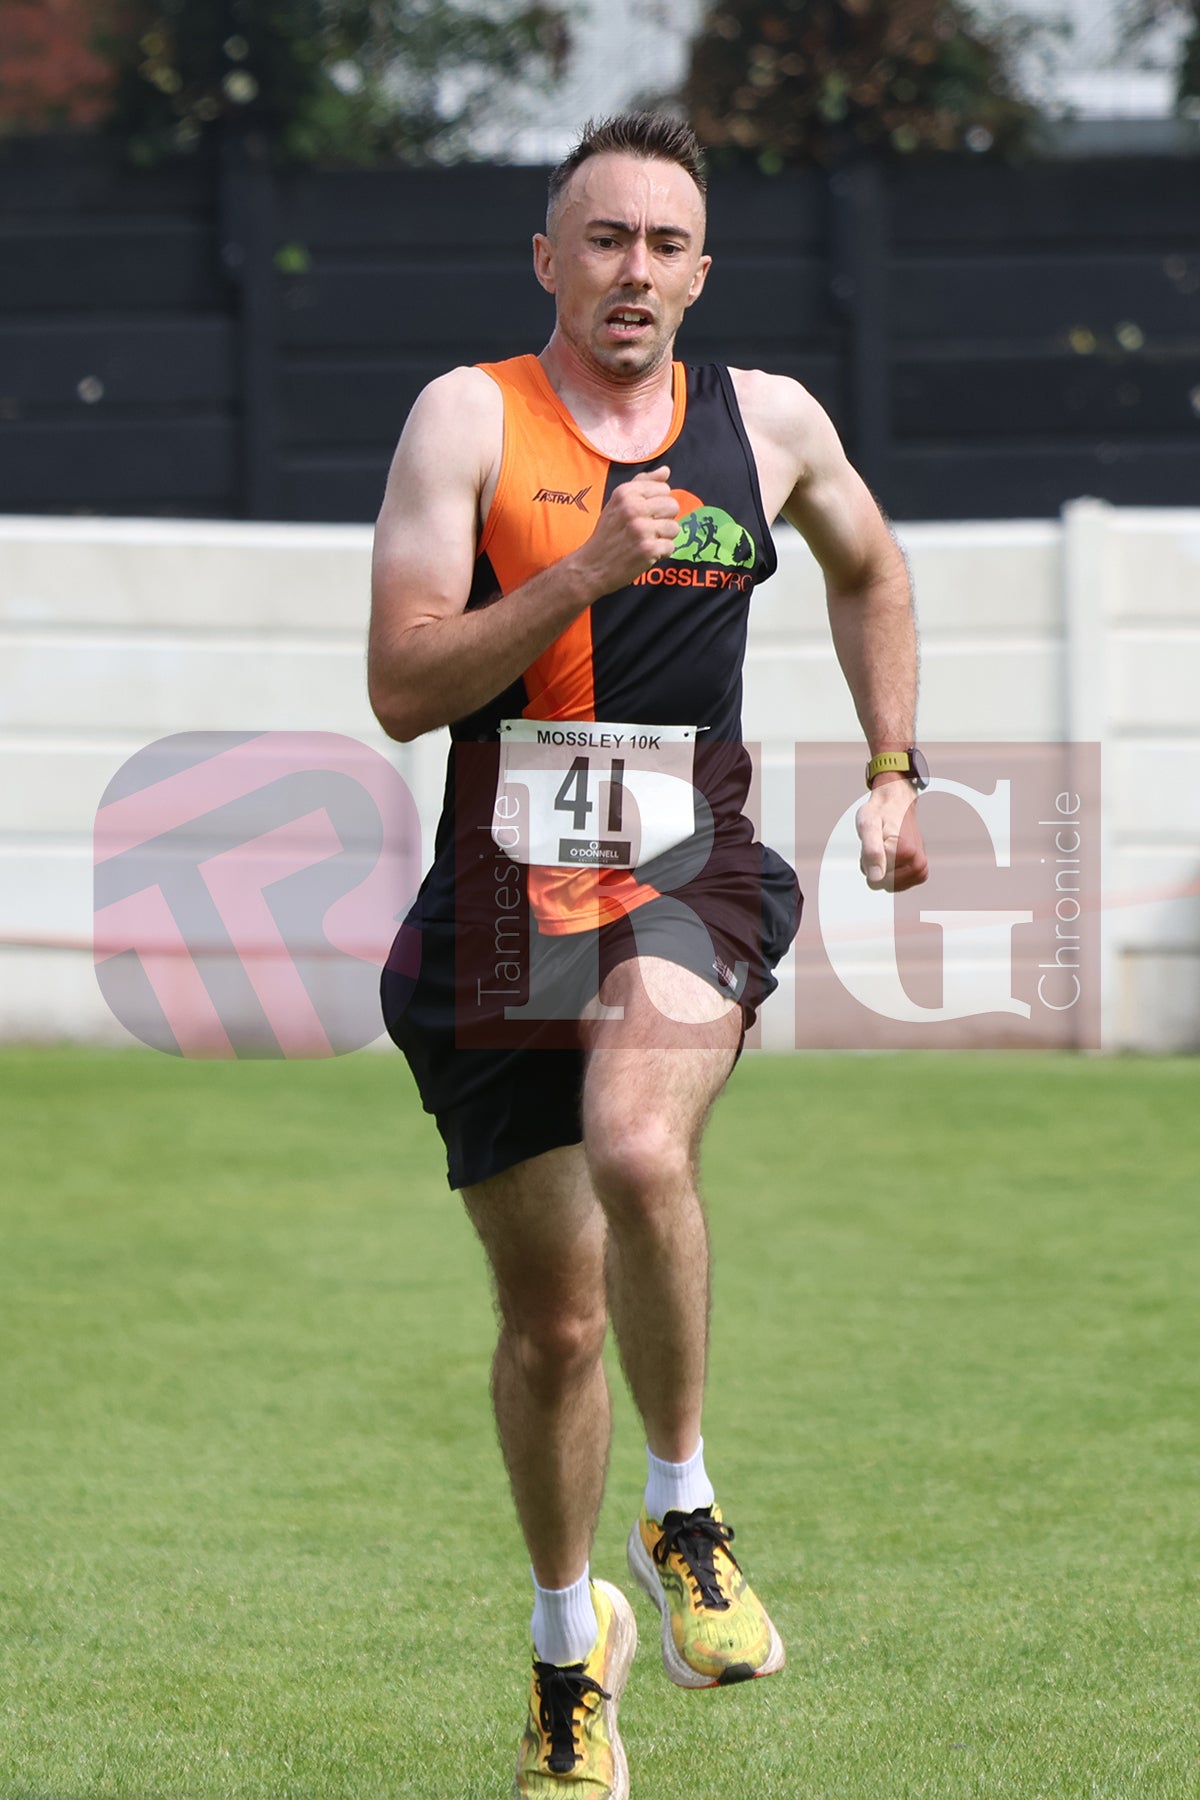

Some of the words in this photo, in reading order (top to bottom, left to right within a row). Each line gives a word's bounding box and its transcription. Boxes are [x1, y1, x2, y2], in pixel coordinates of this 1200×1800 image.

[537, 730, 625, 749] MOSSLEY
[629, 735, 661, 750] 10K
[554, 756, 625, 832] 41
